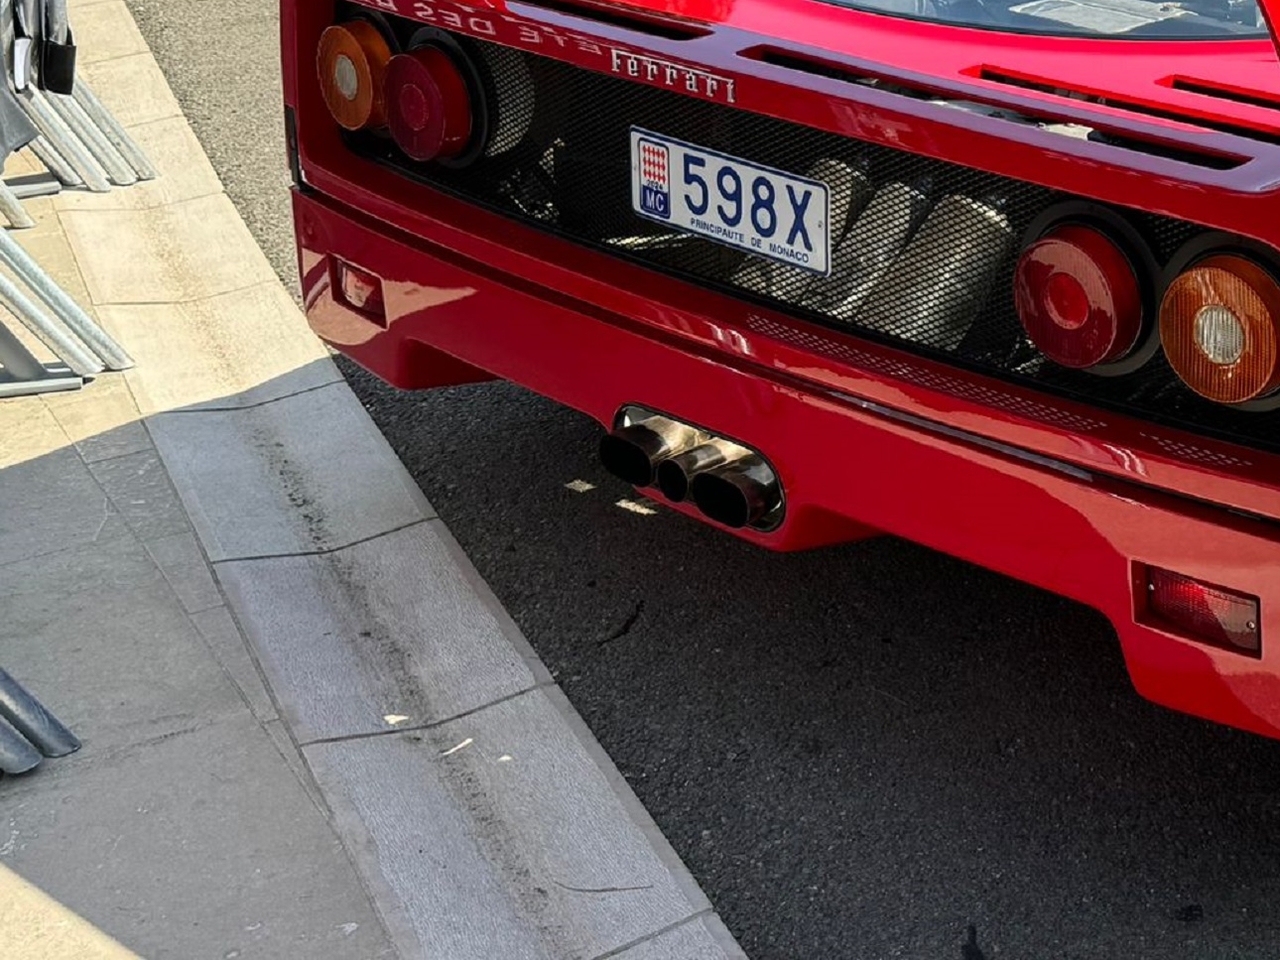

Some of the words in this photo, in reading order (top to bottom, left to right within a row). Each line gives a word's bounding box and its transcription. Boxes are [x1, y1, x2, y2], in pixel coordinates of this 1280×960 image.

[610, 48, 736, 103] Ferrari
[646, 189, 664, 212] MC
[683, 153, 814, 252] 598X
[751, 236, 763, 249] DE
[769, 243, 810, 264] MONACO
